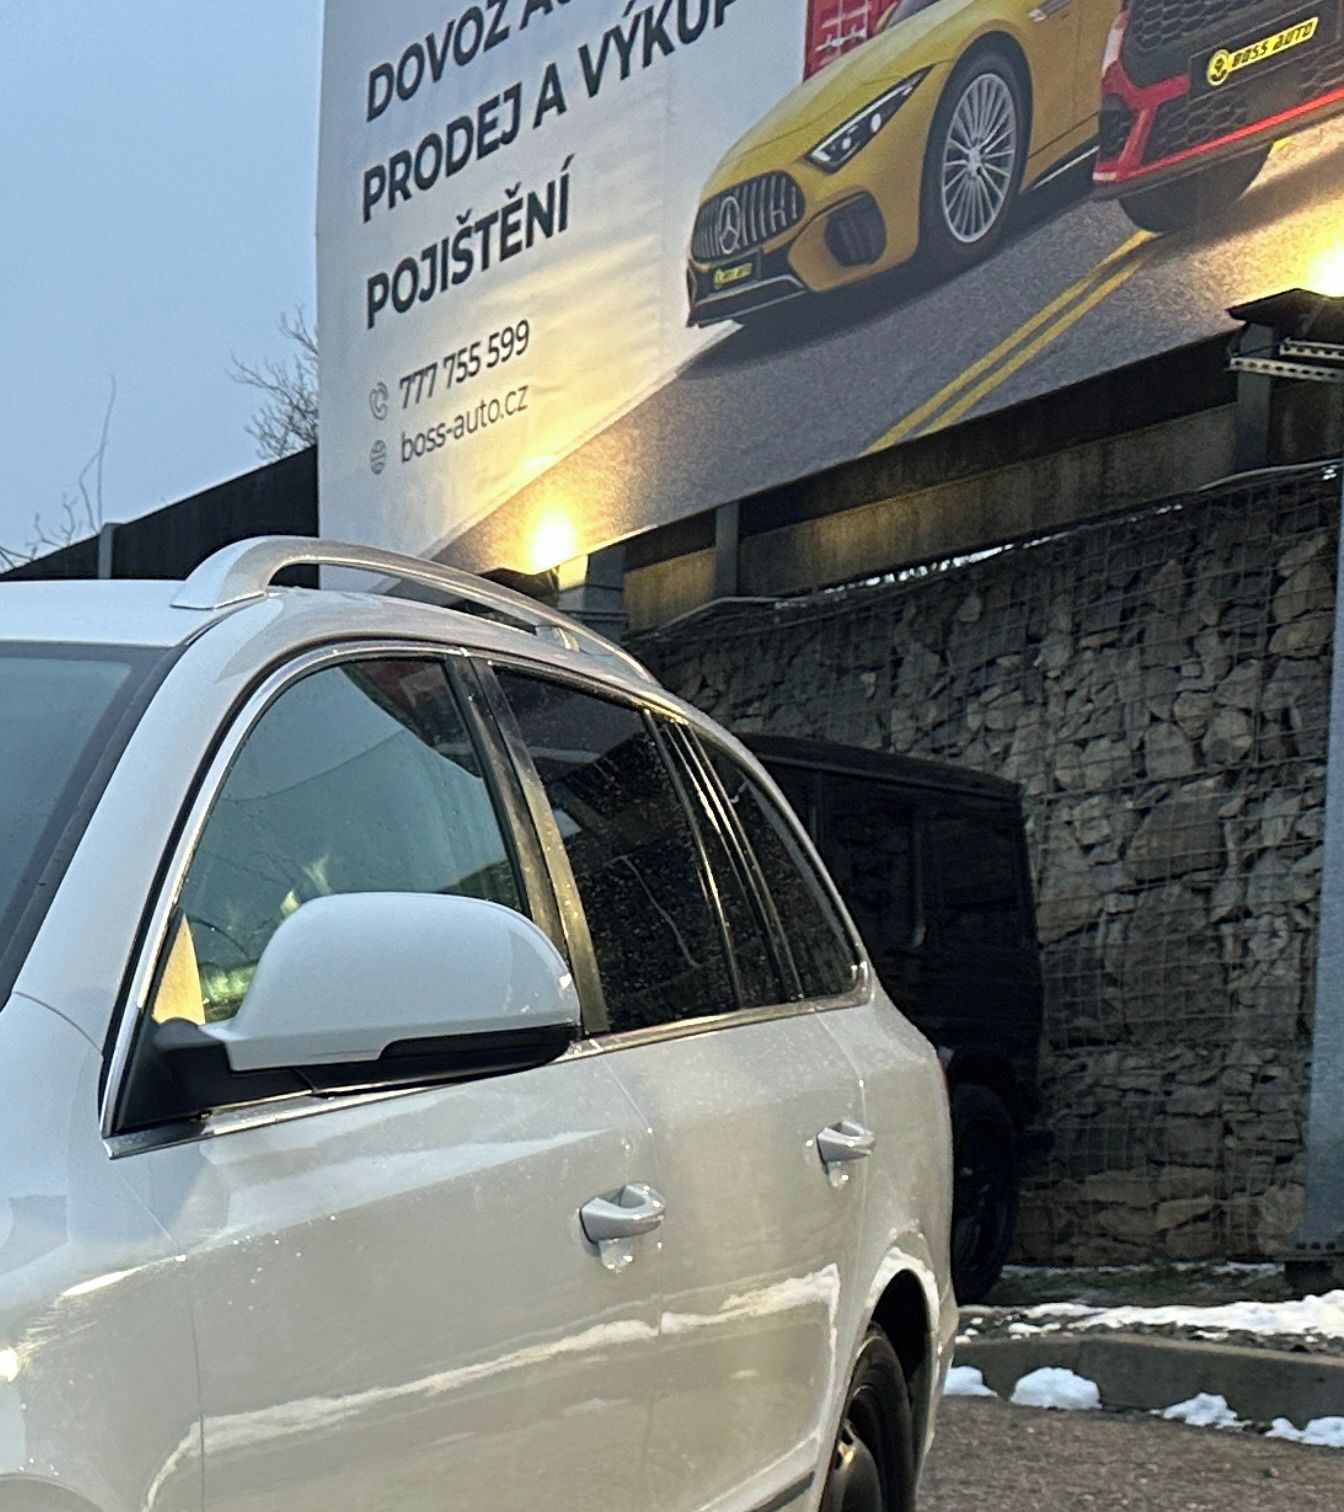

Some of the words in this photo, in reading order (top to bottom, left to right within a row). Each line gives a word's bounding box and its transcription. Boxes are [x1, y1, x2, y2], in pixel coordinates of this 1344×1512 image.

[366, 0, 510, 123] DOVOZ
[362, 82, 523, 225] PRODEJ
[532, 62, 568, 130] A
[366, 152, 576, 330] POJIŠTĚNÍ
[399, 361, 439, 411] 777
[442, 340, 482, 390] 755
[485, 318, 530, 369] 599
[400, 383, 530, 465] boss-auto.cz
